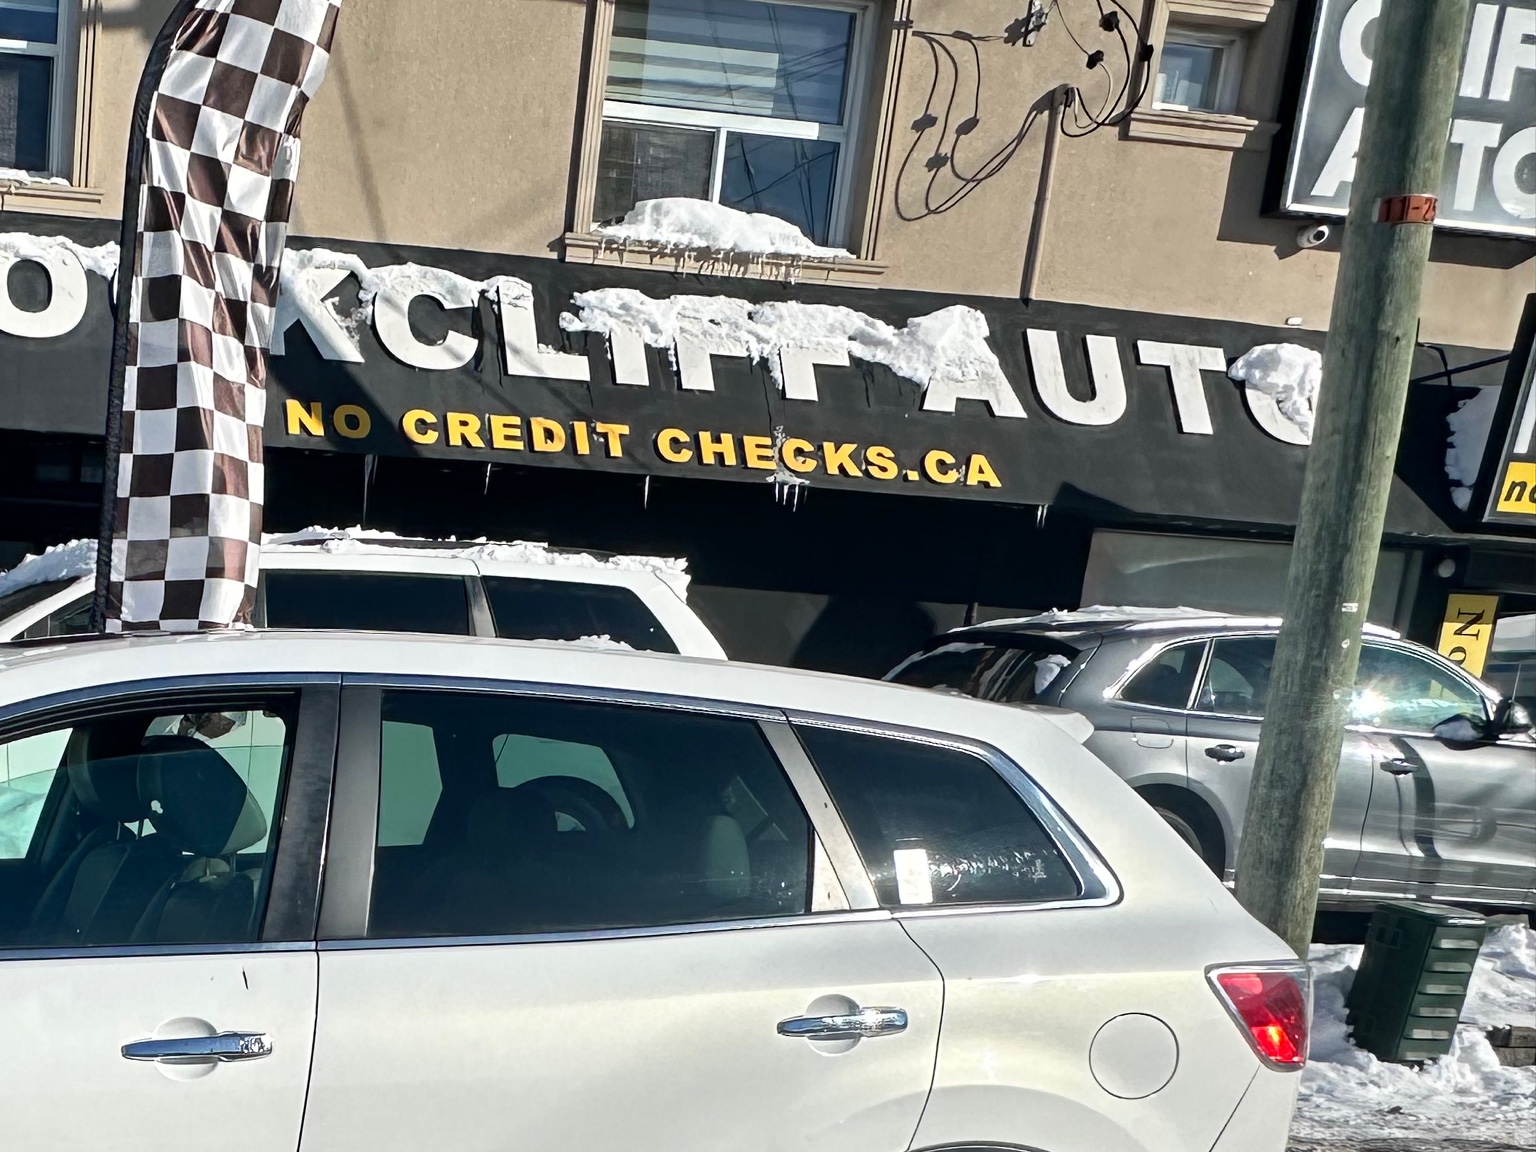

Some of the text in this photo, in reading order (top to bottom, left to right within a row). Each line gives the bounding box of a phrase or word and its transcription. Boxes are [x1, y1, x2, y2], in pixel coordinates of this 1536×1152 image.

[285, 398, 1003, 489] NO CREDIT CHECKS.CA
